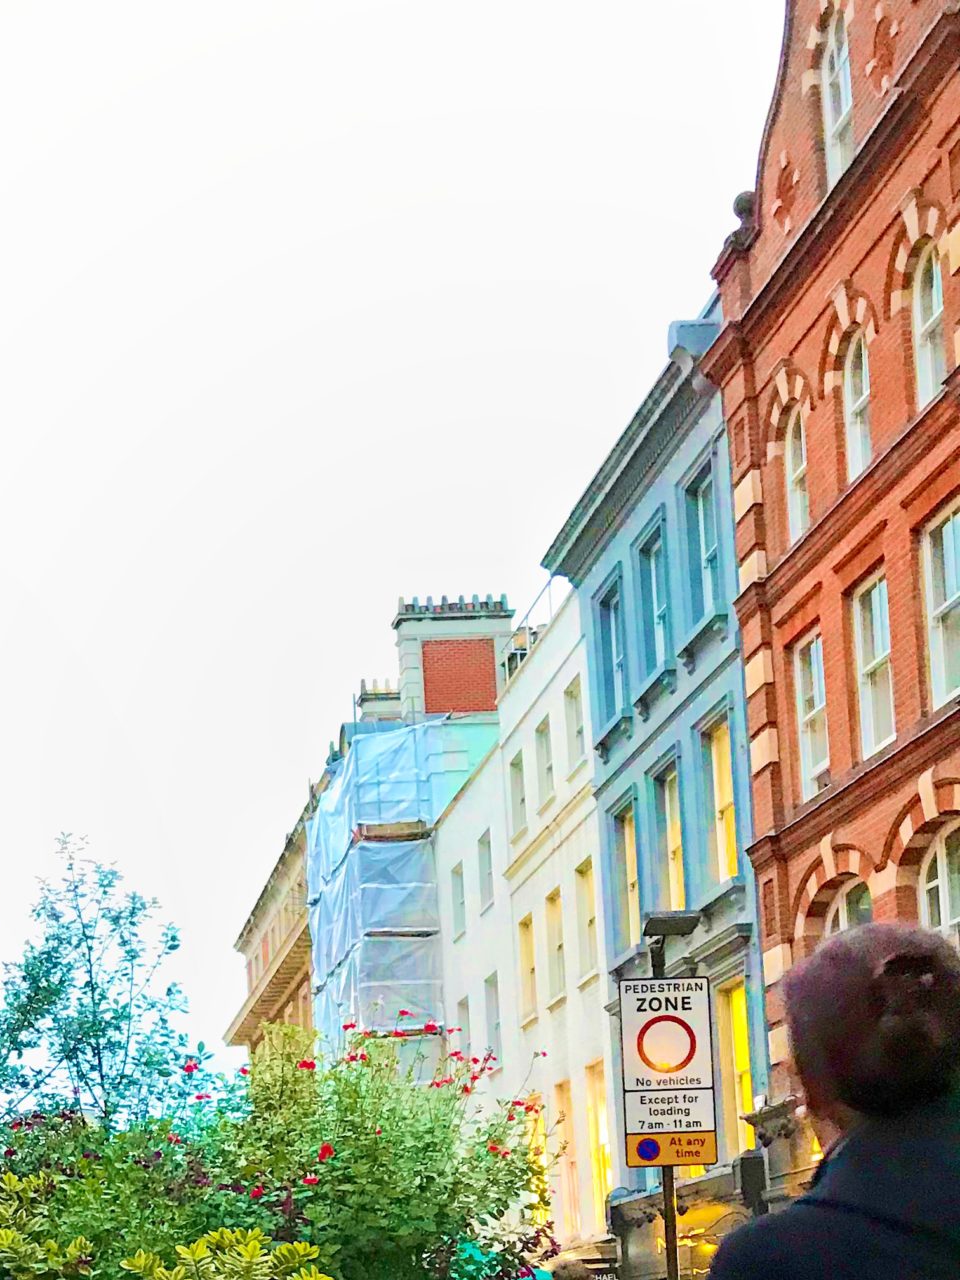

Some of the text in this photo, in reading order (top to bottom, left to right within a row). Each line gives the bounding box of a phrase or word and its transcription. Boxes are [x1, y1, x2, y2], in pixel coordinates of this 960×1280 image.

[624, 982, 703, 994] PEDESTRIAN
[636, 996, 692, 1012] ZONE
[636, 1075, 702, 1087] No vehicles
[640, 1094, 699, 1105] Except for
[649, 1106, 690, 1117] loading
[669, 1137, 706, 1147] At any
[676, 1149, 701, 1158] time
